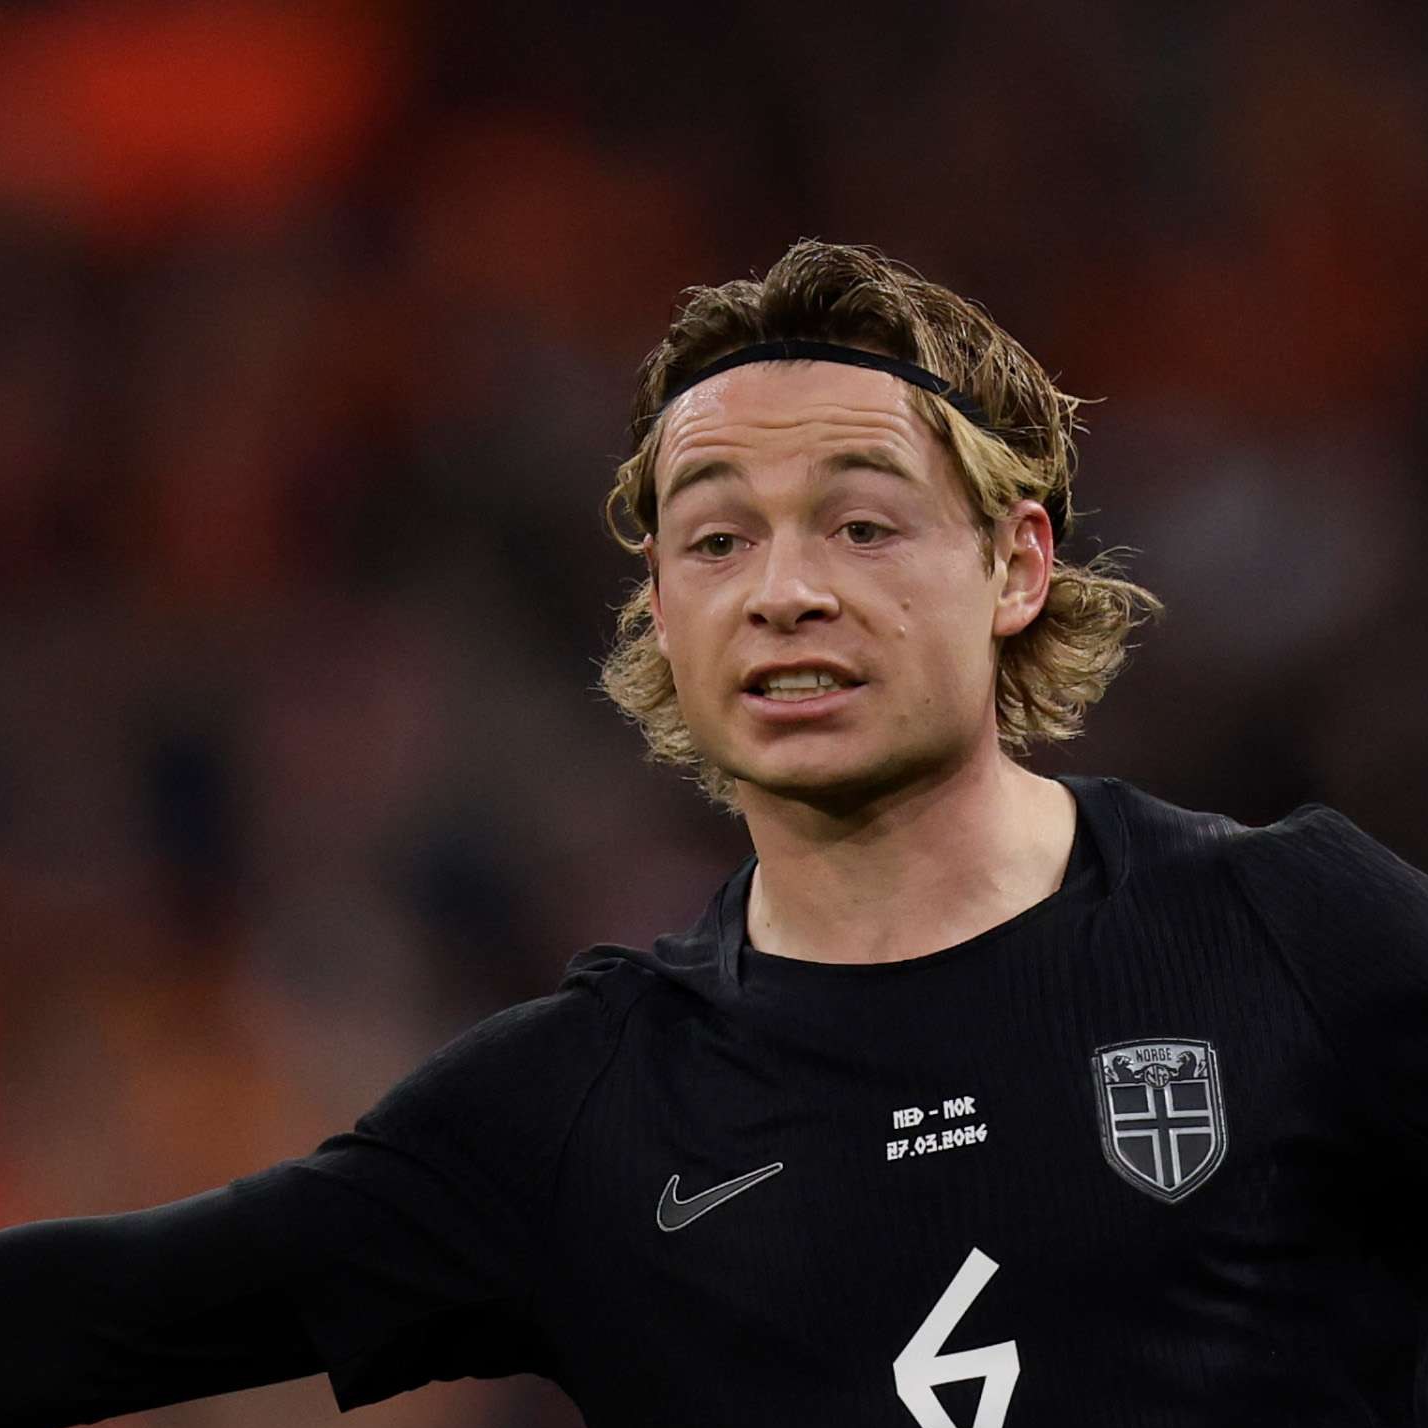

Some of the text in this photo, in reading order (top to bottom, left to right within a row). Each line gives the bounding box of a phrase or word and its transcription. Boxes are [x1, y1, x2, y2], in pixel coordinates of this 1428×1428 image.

[1136, 1047, 1172, 1062] NORGE
[893, 1107, 924, 1130] NED
[943, 1096, 976, 1120] NOR
[886, 1123, 988, 1161] 27.03.2026
